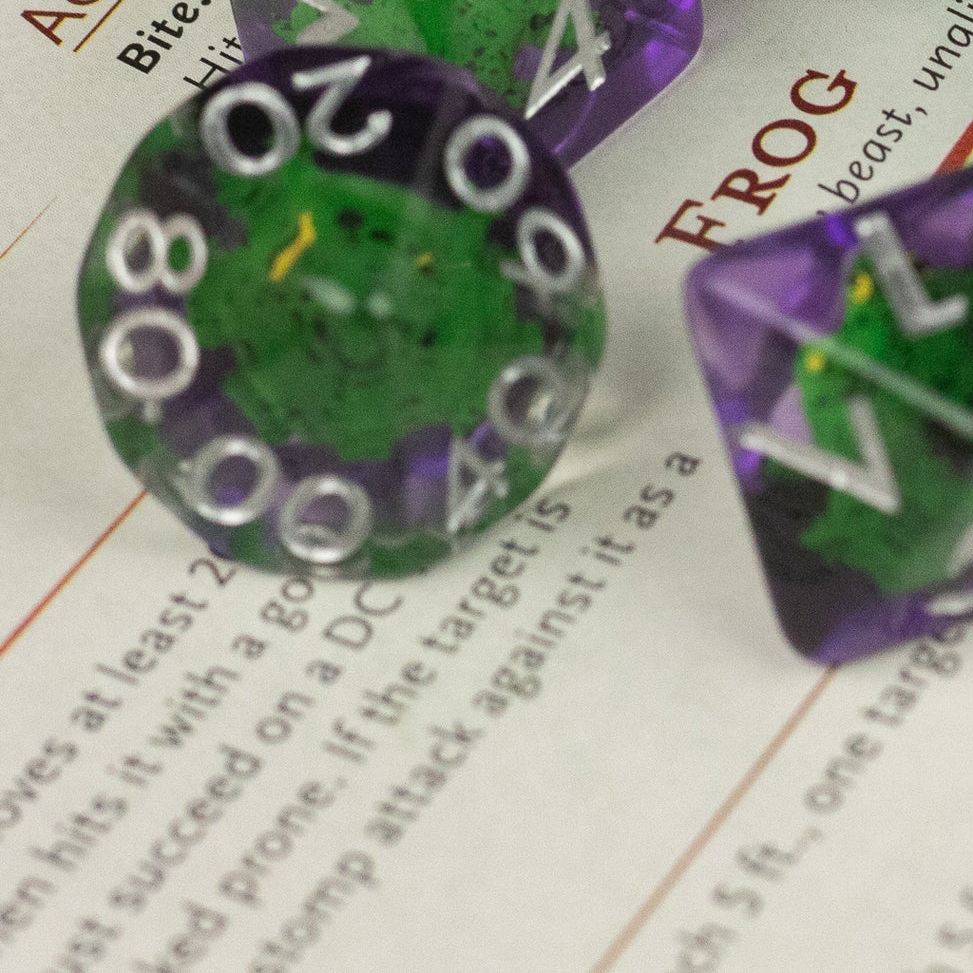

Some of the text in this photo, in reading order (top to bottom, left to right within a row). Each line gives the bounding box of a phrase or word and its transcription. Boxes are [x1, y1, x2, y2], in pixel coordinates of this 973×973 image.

[653, 68, 858, 253] FROG
[817, 106, 929, 205] beast,
[70, 688, 124, 733] at
[93, 590, 209, 686] least
[218, 776, 348, 909] prone.
[322, 716, 376, 765] If
[357, 659, 439, 729] the
[420, 536, 542, 656] target
[363, 720, 486, 848] attack
[472, 572, 607, 719] against
[581, 533, 637, 568] it
[623, 481, 676, 530] as
[665, 450, 701, 478] a
[28, 790, 130, 873] hits
[148, 663, 243, 750] with
[231, 632, 270, 661] a
[107, 741, 265, 915] succeed
[255, 689, 316, 746] on
[305, 657, 344, 688] a
[804, 731, 885, 816] one
